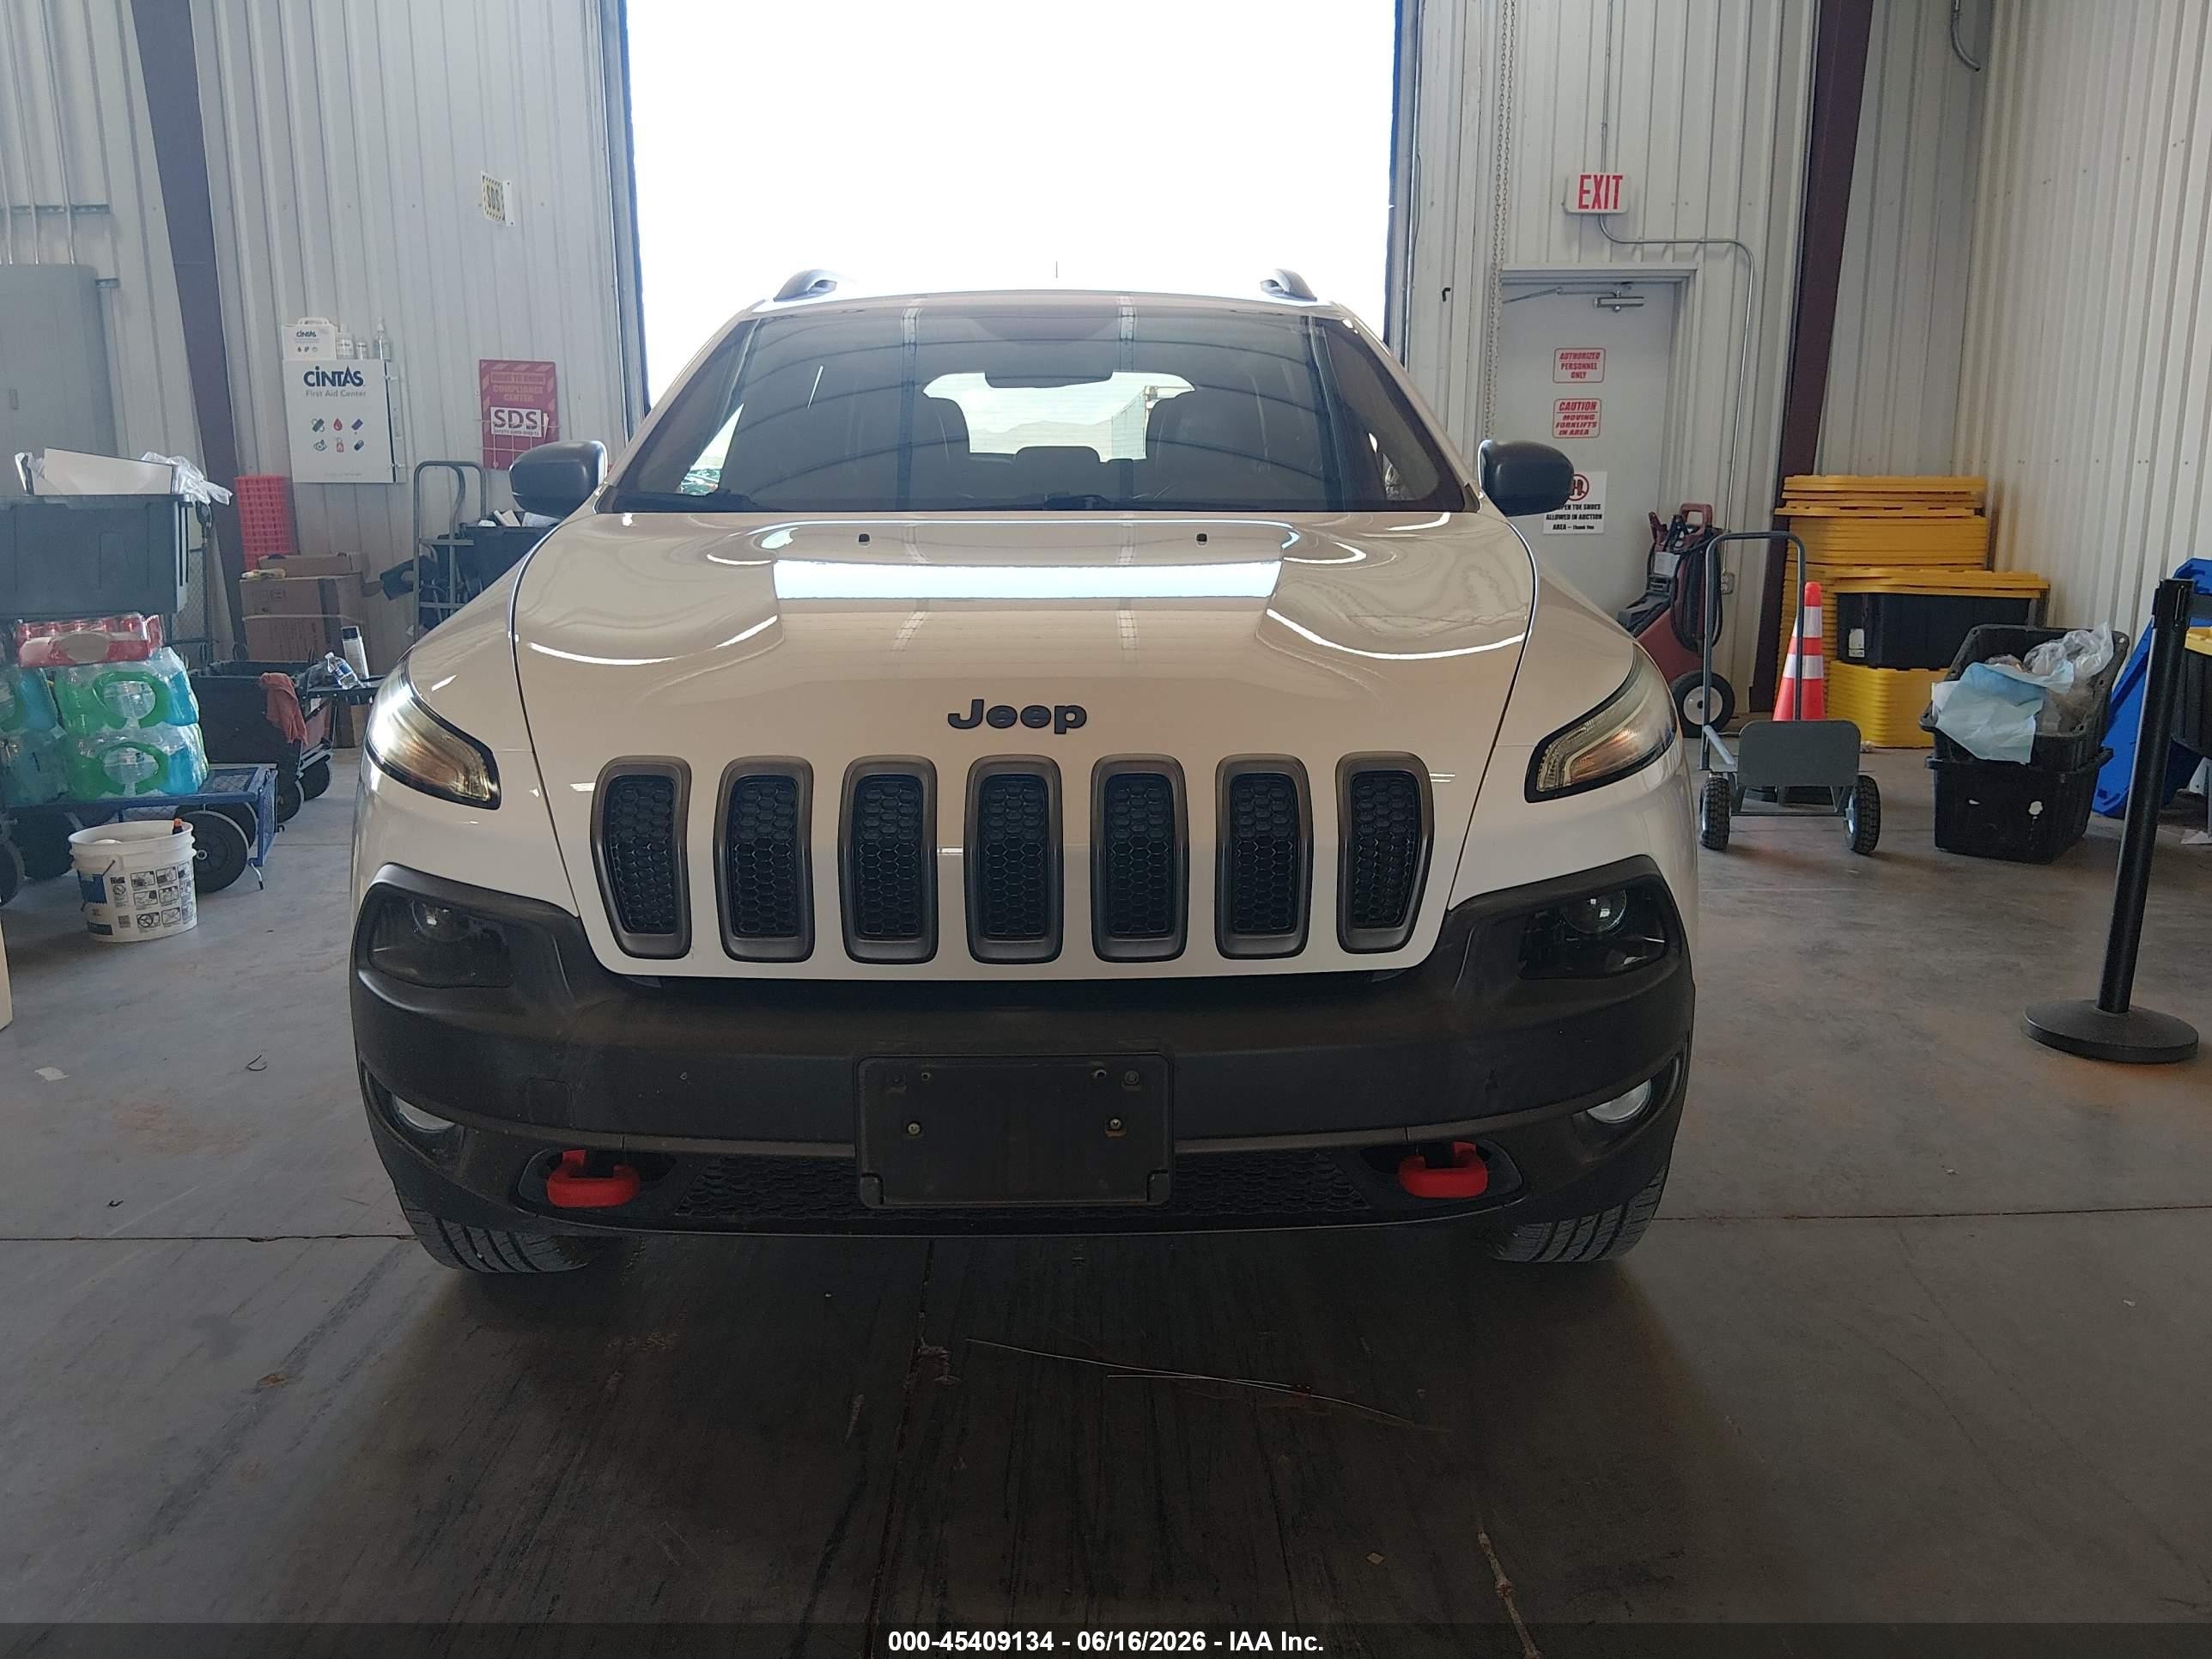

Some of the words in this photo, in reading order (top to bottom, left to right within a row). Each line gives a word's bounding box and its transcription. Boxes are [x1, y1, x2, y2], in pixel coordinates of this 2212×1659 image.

[1578, 174, 1623, 210] EXIT
[494, 410, 538, 429] SDS
[1559, 401, 1597, 411] CAUTION
[948, 699, 1087, 735] Jeep
